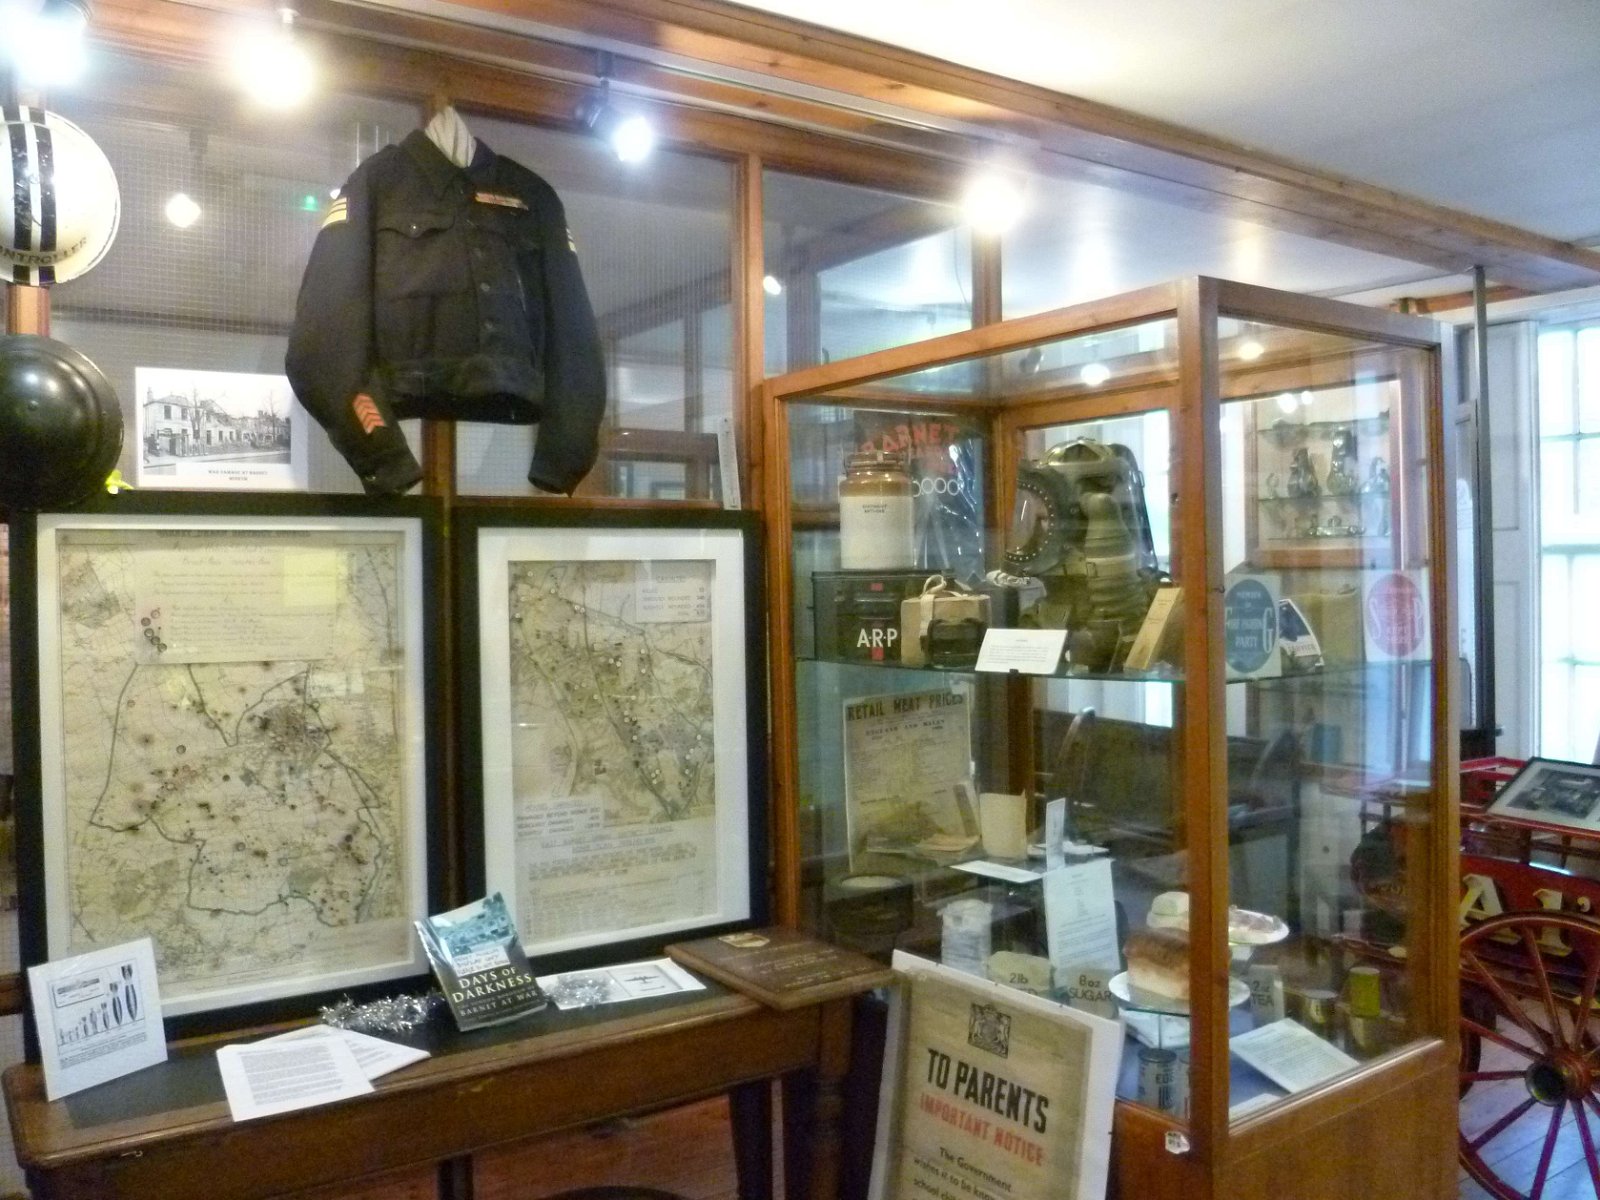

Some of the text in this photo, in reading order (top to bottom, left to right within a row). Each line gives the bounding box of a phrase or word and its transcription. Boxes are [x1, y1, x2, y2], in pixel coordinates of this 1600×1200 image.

[847, 702, 886, 721] RETAIL
[894, 696, 921, 714] MEAT
[452, 973, 532, 1003] DARKNESS
[458, 966, 517, 989] DAYS OF
[460, 1002, 498, 1017] BARNET
[501, 998, 513, 1009] AT
[516, 990, 538, 1002] WAR
[1068, 987, 1112, 1001] SUGAR
[927, 1047, 1050, 1134] TO PARENTS
[919, 1091, 1046, 1167] IMPORTANT NOTICE
[913, 1156, 940, 1176] wishes
[949, 1174, 960, 1186] to
[961, 1179, 973, 1193] be
[939, 1146, 1012, 1192] The Government
[913, 1177, 941, 1197] school
